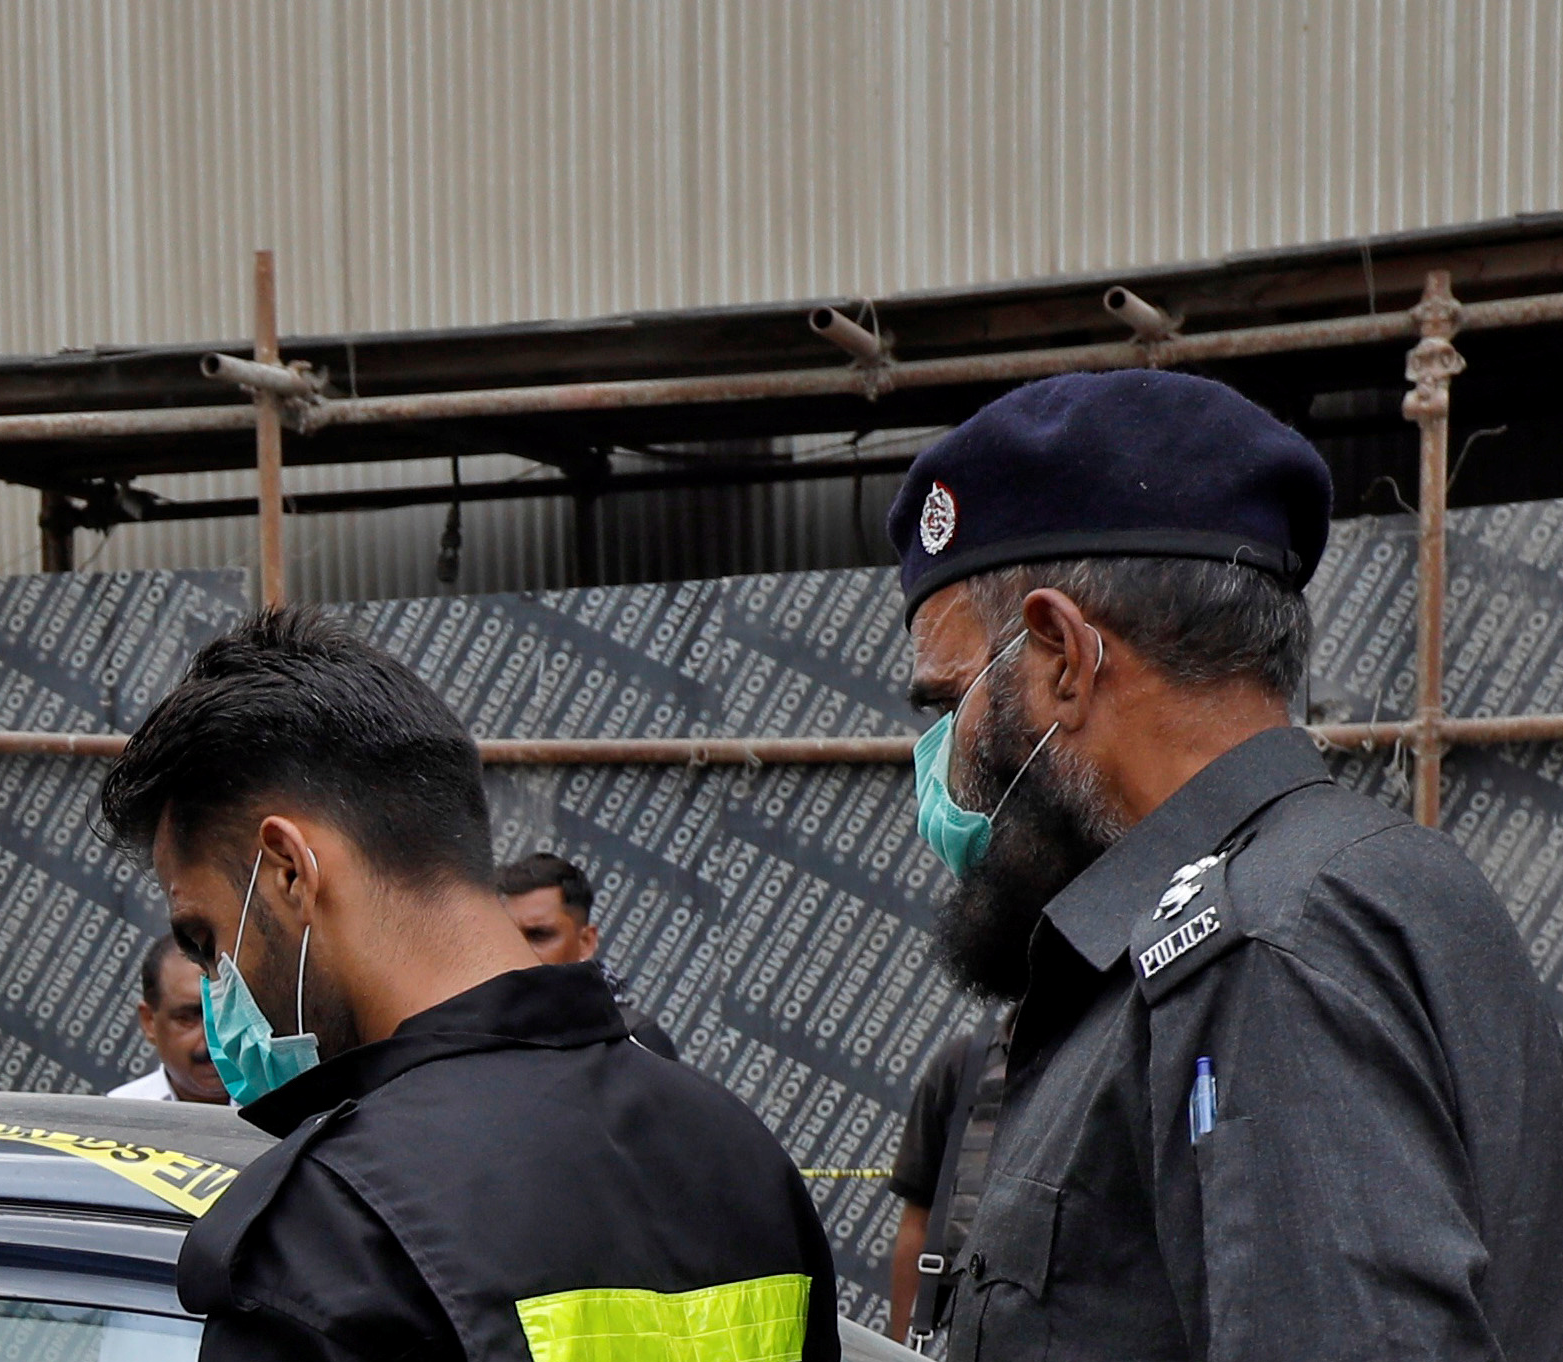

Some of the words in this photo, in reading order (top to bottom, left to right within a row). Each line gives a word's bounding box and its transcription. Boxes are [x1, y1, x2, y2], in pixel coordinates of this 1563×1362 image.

[38, 574, 89, 650] EMDO
[69, 568, 132, 668] OREMDO
[100, 568, 174, 686] KOREMDO
[410, 597, 473, 681] EMDO
[440, 614, 507, 706] REMDO
[641, 575, 705, 661] KORE
[815, 567, 870, 649] EMDO
[851, 590, 903, 670] EMDO
[1300, 540, 1398, 678] KOREMDO
[1340, 563, 1433, 693] KOREMD
[1430, 589, 1516, 708] OREMDO
[462, 631, 542, 742] OREMDO
[506, 648, 576, 742] REMDO
[551, 666, 607, 740] EMDO
[713, 652, 773, 743] KORE
[1470, 607, 1553, 723] OREMDO
[588, 702, 679, 829] KORDO
[622, 719, 713, 846] KOREO
[726, 670, 809, 802] KORO
[762, 688, 845, 819] KODO
[660, 771, 728, 864] KOREM
[870, 802, 916, 871] EMDO
[5, 886, 78, 1001] KOREMDO
[35, 904, 108, 1019] KOREMDO
[600, 883, 663, 968] EMDO
[620, 904, 696, 1008] OREMDO
[652, 923, 729, 1030] OREMDO
[747, 876, 827, 1005] KOREMDO
[782, 894, 863, 1023] KOREMDO
[817, 912, 898, 1041] KOREMDO
[1139, 906, 1221, 979] POLICE
[66, 923, 139, 1038] KOREMDO
[97, 981, 147, 1056] EMDO
[887, 973, 953, 1077] REMDO
[762, 1061, 809, 1131] KORE
[788, 1080, 844, 1167] KOREM
